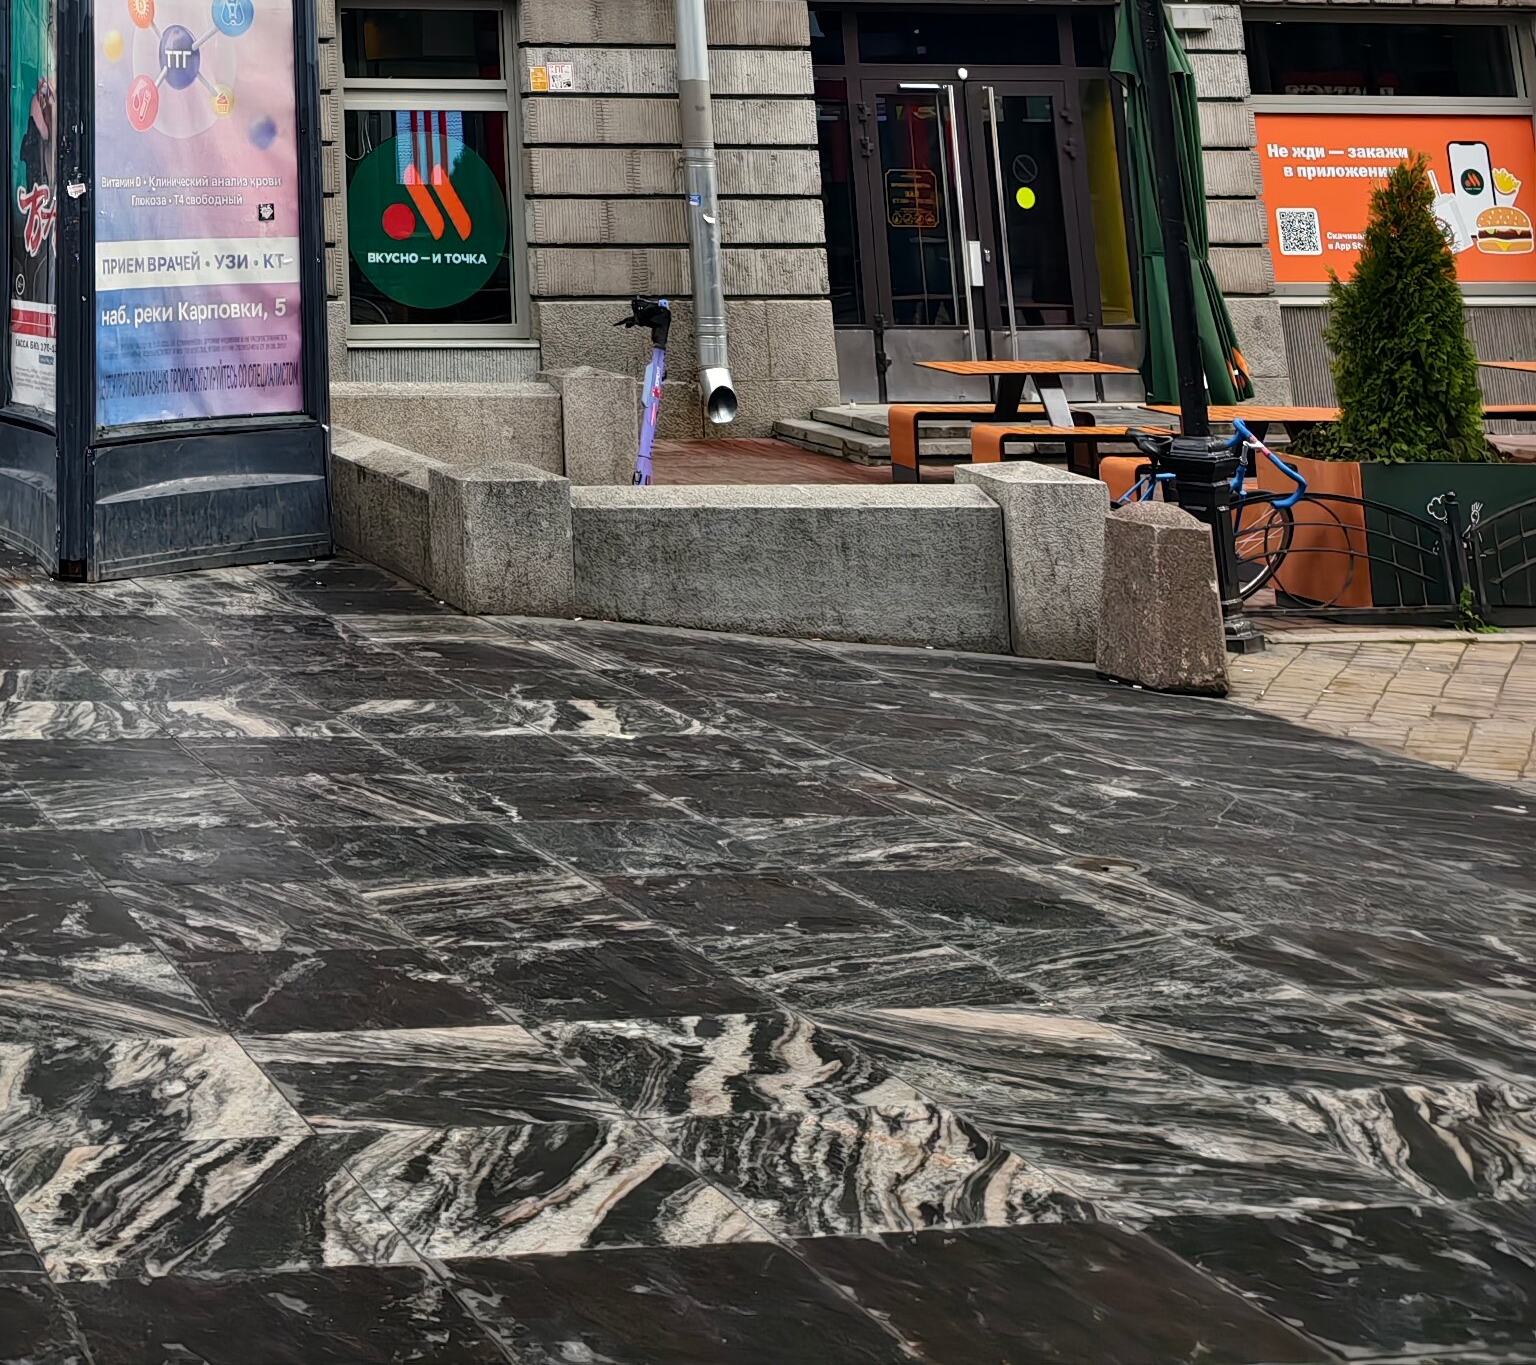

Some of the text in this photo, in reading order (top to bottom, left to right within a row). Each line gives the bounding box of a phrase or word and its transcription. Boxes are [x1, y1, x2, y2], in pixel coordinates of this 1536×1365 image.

[165, 49, 192, 68] ТТГ
[1267, 143, 1288, 158] Не
[1291, 146, 1325, 160] жди
[1347, 146, 1408, 159] закажи
[1283, 166, 1294, 177] в
[101, 176, 135, 188] Витамин
[148, 175, 209, 188] Клинический
[211, 177, 248, 187] анализ
[250, 177, 282, 188] крови
[131, 195, 167, 206] Глюкоза
[185, 193, 243, 206] свободный
[1326, 231, 1366, 240] Скачива
[102, 256, 145, 275] ПРИЕМ
[147, 251, 201, 272] ВРАЧЕЙ
[214, 254, 248, 270] УЗИ
[367, 252, 419, 264] ВКУСНО
[432, 253, 442, 264] И
[444, 253, 488, 264] ТОЧКА
[102, 298, 287, 328] наб. реки Карповки, 5
